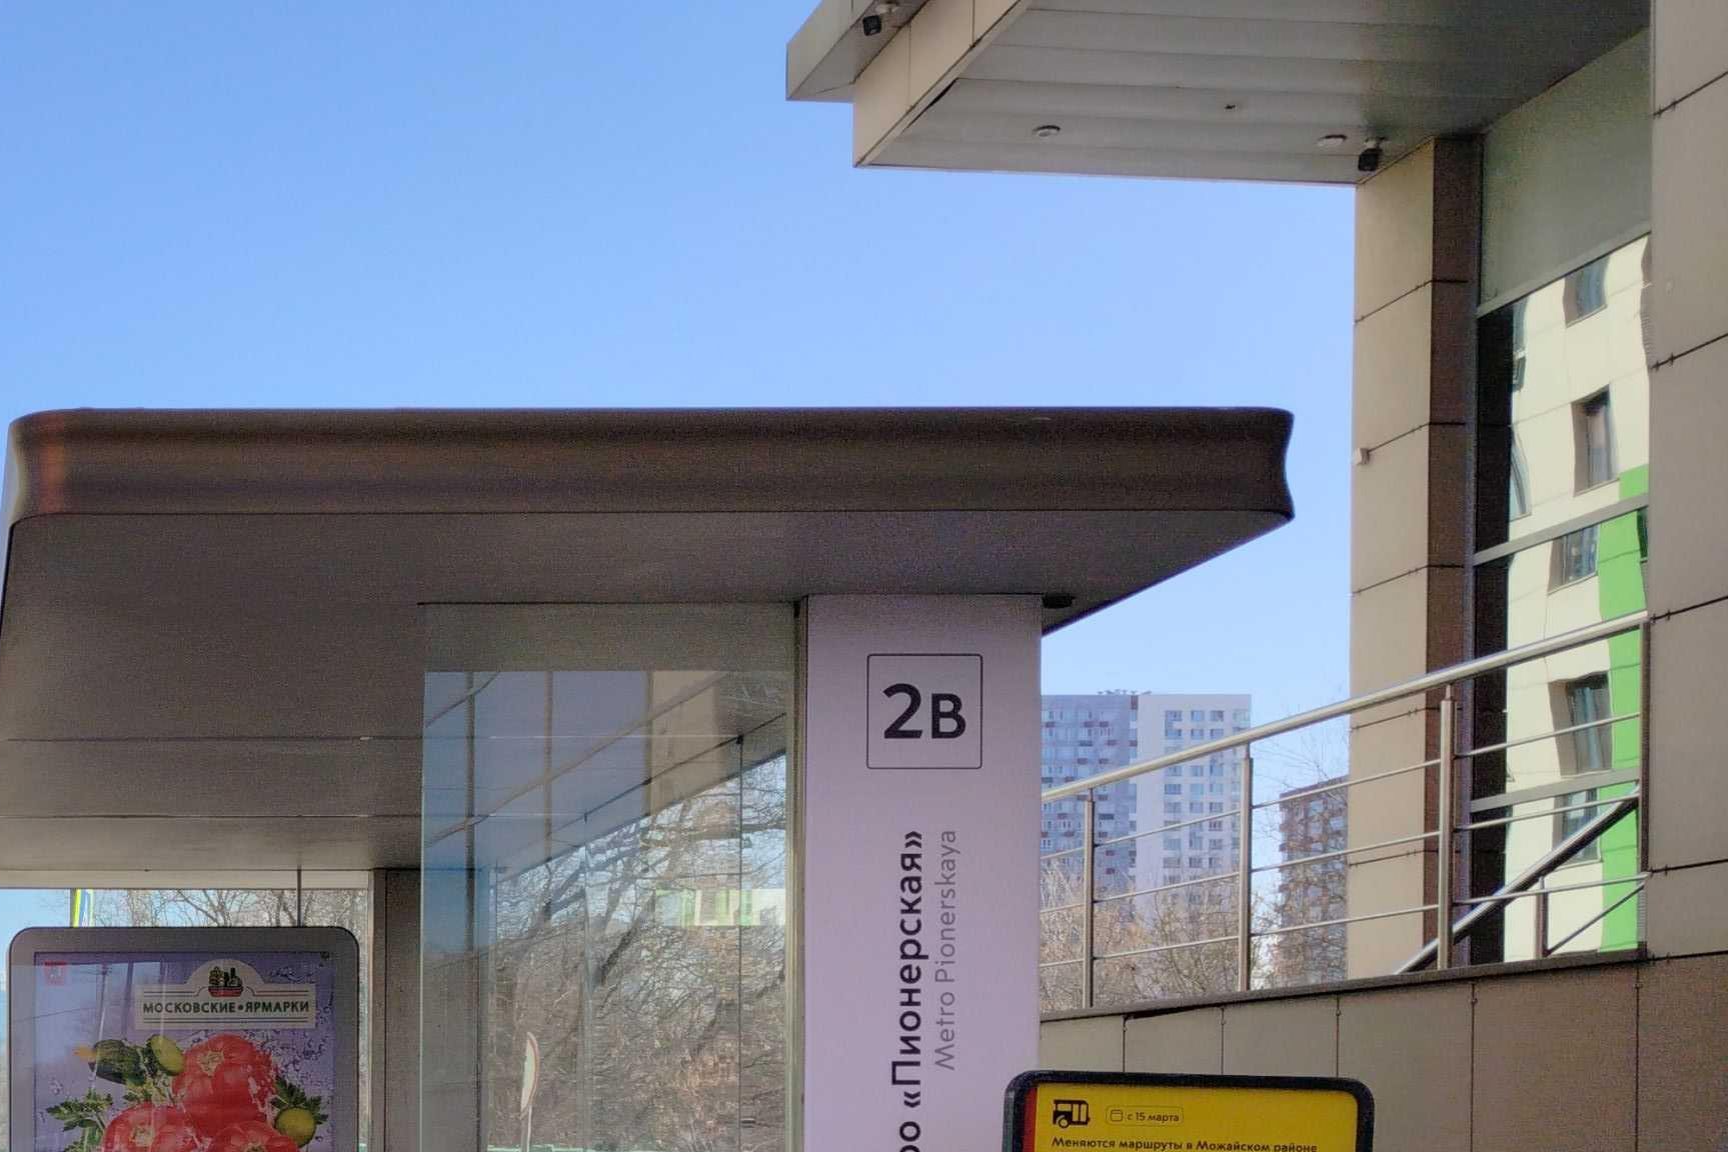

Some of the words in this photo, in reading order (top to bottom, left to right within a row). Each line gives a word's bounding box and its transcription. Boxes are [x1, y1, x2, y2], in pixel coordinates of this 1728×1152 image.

[882, 682, 967, 740] 2В
[934, 829, 963, 984] Pionerskaya
[891, 830, 929, 1108] «Пионерская»
[143, 1000, 237, 1014] МОСКОВСКИЕ
[244, 1000, 310, 1013] ЯРМАРКИ
[933, 991, 956, 1070] Metro
[1051, 1137, 1116, 1148] Меняются
[1119, 1140, 1183, 1152] маршруты
[1186, 1142, 1193, 1150] в
[1196, 1141, 1271, 1152] Можайском
[1127, 1113, 1133, 1121] с
[1135, 1111, 1145, 1121] 15
[1147, 1114, 1180, 1124] марта
